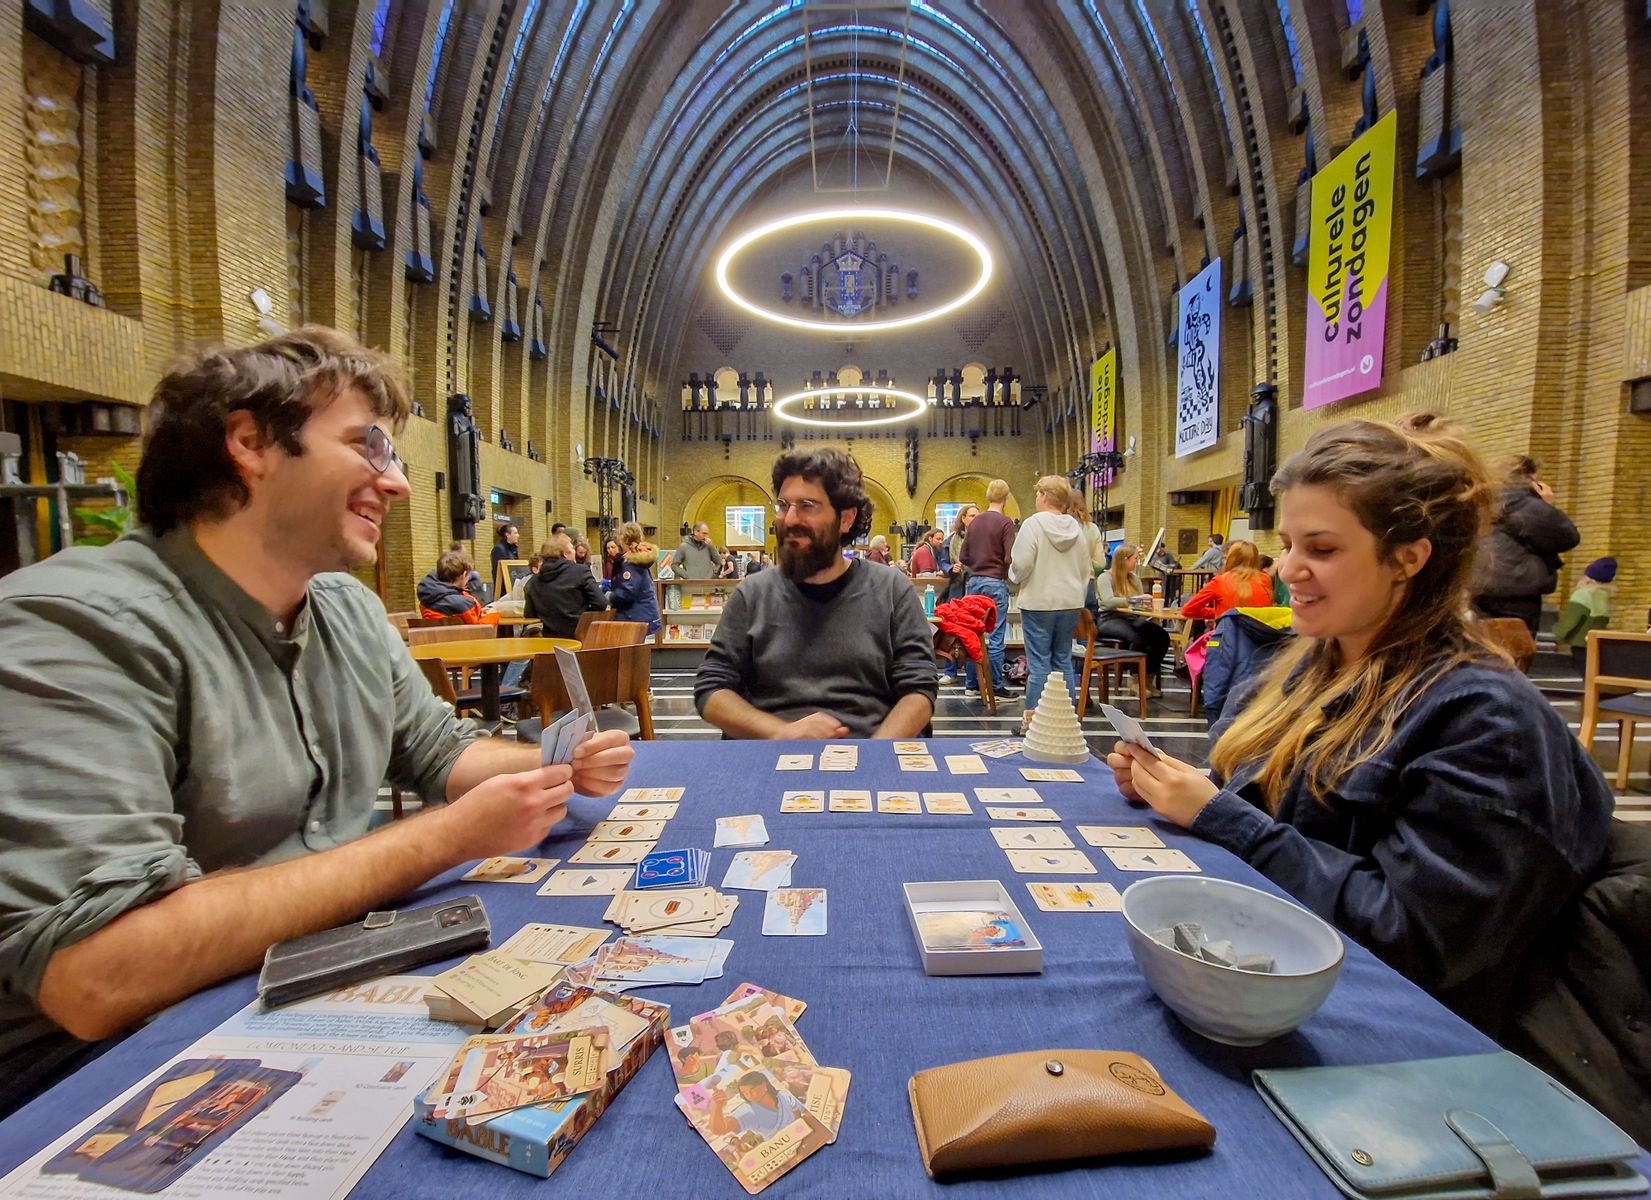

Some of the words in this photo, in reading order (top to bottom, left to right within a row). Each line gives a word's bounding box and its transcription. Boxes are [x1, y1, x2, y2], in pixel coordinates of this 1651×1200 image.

[1345, 151, 1375, 344] zondagen
[1322, 184, 1346, 342] culturele
[325, 983, 423, 1004] BABL
[573, 1047, 584, 1075] SURRIS
[760, 1134, 790, 1158] BANU
